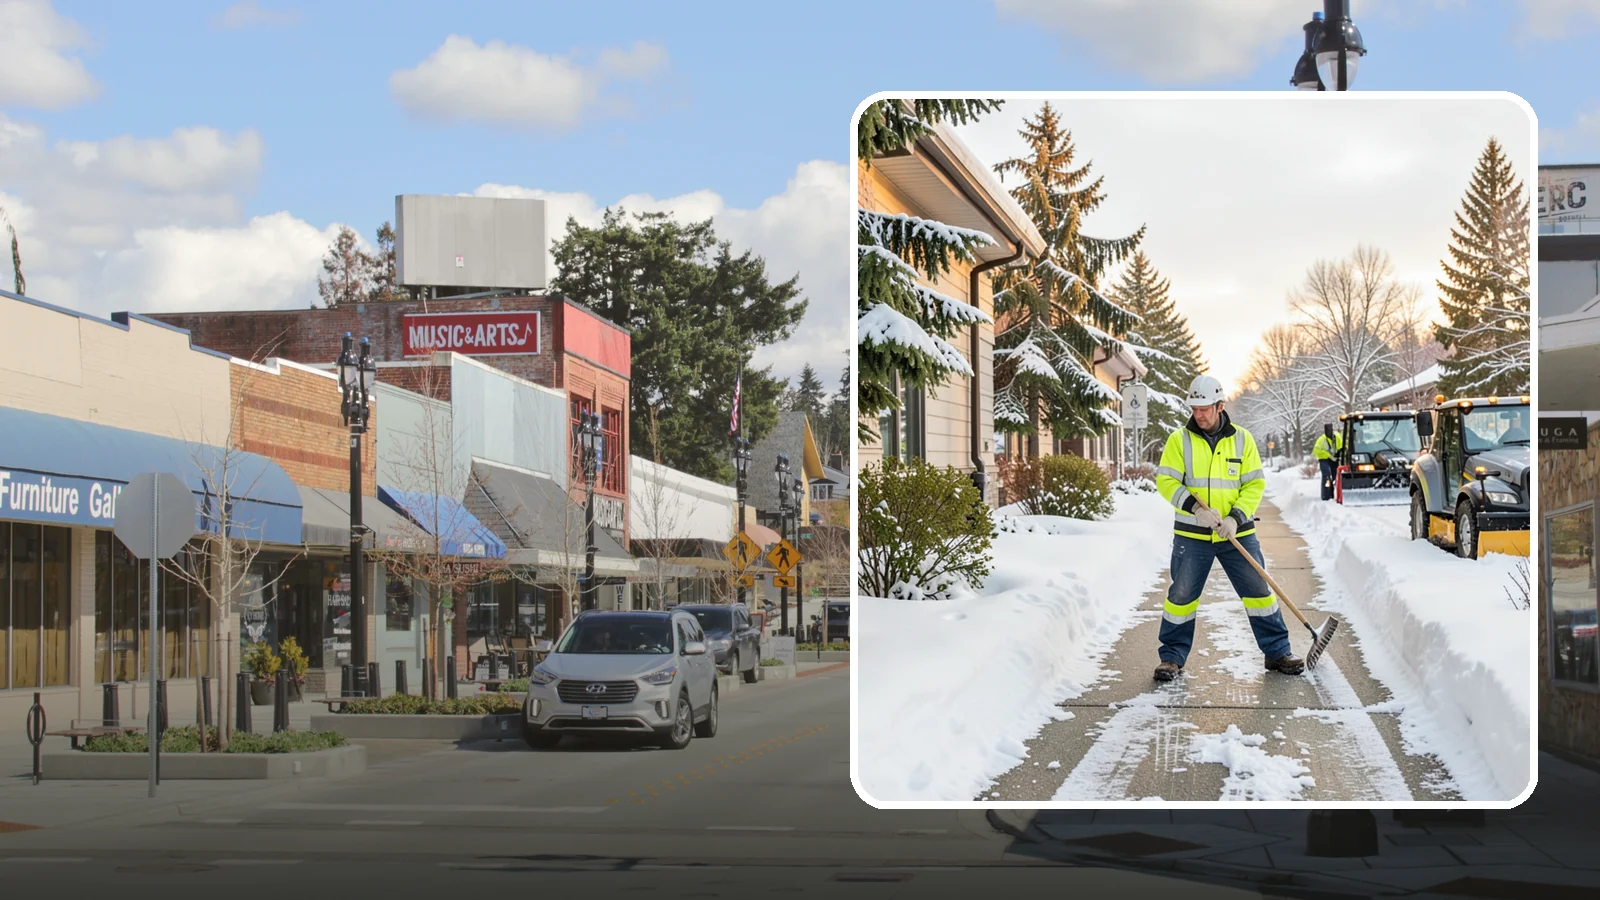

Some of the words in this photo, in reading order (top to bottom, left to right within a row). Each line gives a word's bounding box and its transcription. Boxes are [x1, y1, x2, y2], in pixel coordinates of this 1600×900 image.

[409, 322, 520, 349] MUSIC&ARTS
[0, 472, 79, 515] Furniture
[453, 563, 480, 574] SUSHI
